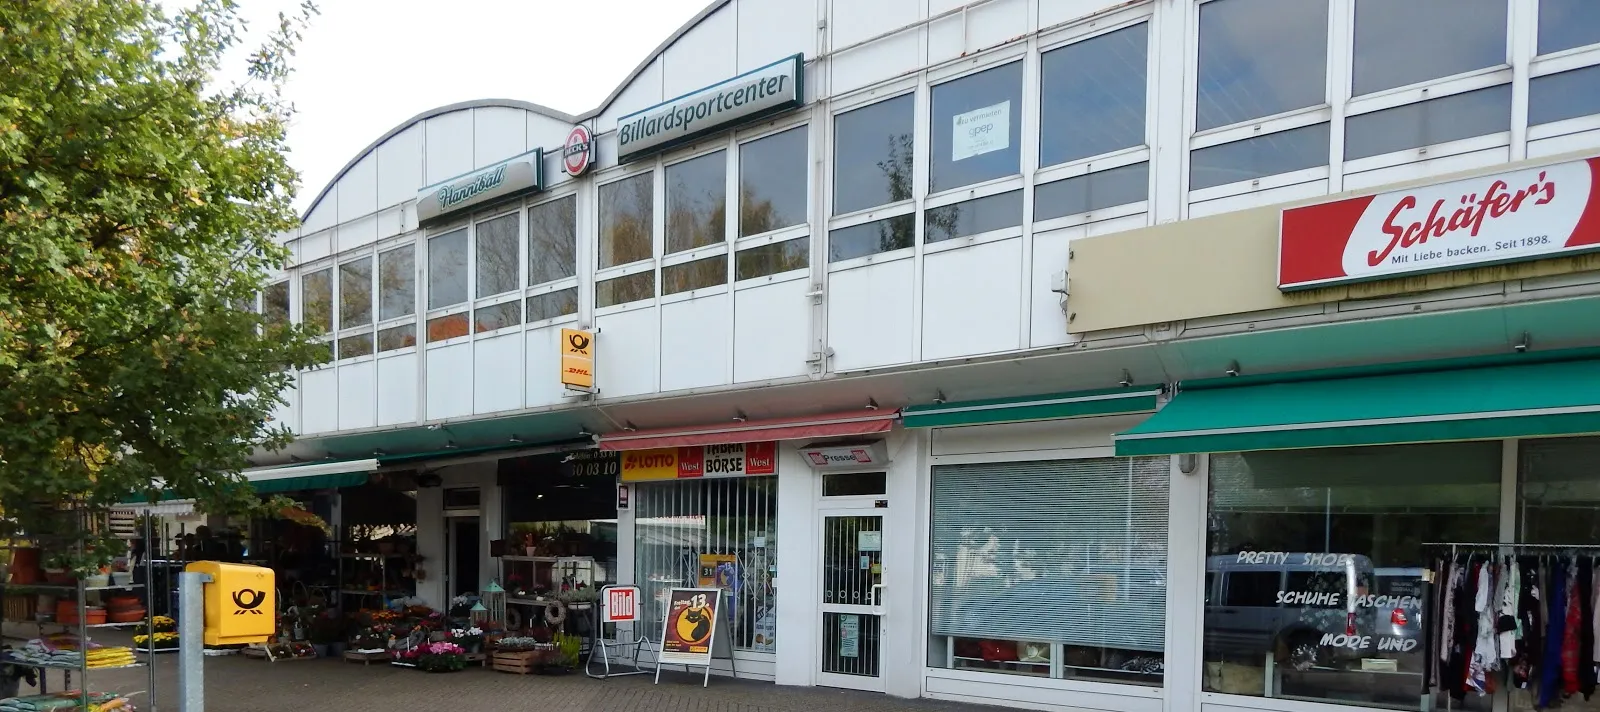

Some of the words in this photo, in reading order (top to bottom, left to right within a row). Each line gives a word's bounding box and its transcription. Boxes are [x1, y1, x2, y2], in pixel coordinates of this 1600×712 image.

[620, 74, 788, 146] Billardsportcenter
[969, 109, 1001, 122] vermieten
[968, 123, 993, 138] gpep
[438, 164, 507, 210] Hanniball
[1367, 170, 1555, 267] Schäfer's
[1391, 254, 1408, 265] Mit
[1414, 249, 1442, 262] Liebe
[1447, 245, 1490, 258] backen.
[1495, 240, 1518, 251] Seit
[1520, 234, 1551, 248] 1898.
[568, 367, 589, 376] DHL
[639, 454, 674, 469] LOTTO
[706, 455, 743, 473] BÖRSE
[750, 457, 770, 467] West
[823, 454, 856, 462] Presse
[586, 462, 600, 476] 03
[603, 461, 616, 475] 10
[680, 462, 700, 471] West
[1236, 551, 1289, 565] PRETTY
[1302, 553, 1356, 567] SHOES
[703, 568, 712, 576] 31
[611, 591, 633, 617] Bild
[691, 593, 710, 609] 13.
[1275, 590, 1340, 606] SCHUHE
[1347, 594, 1422, 609] TASCHEN
[1320, 633, 1372, 650] MODE
[1378, 637, 1418, 652] UND
